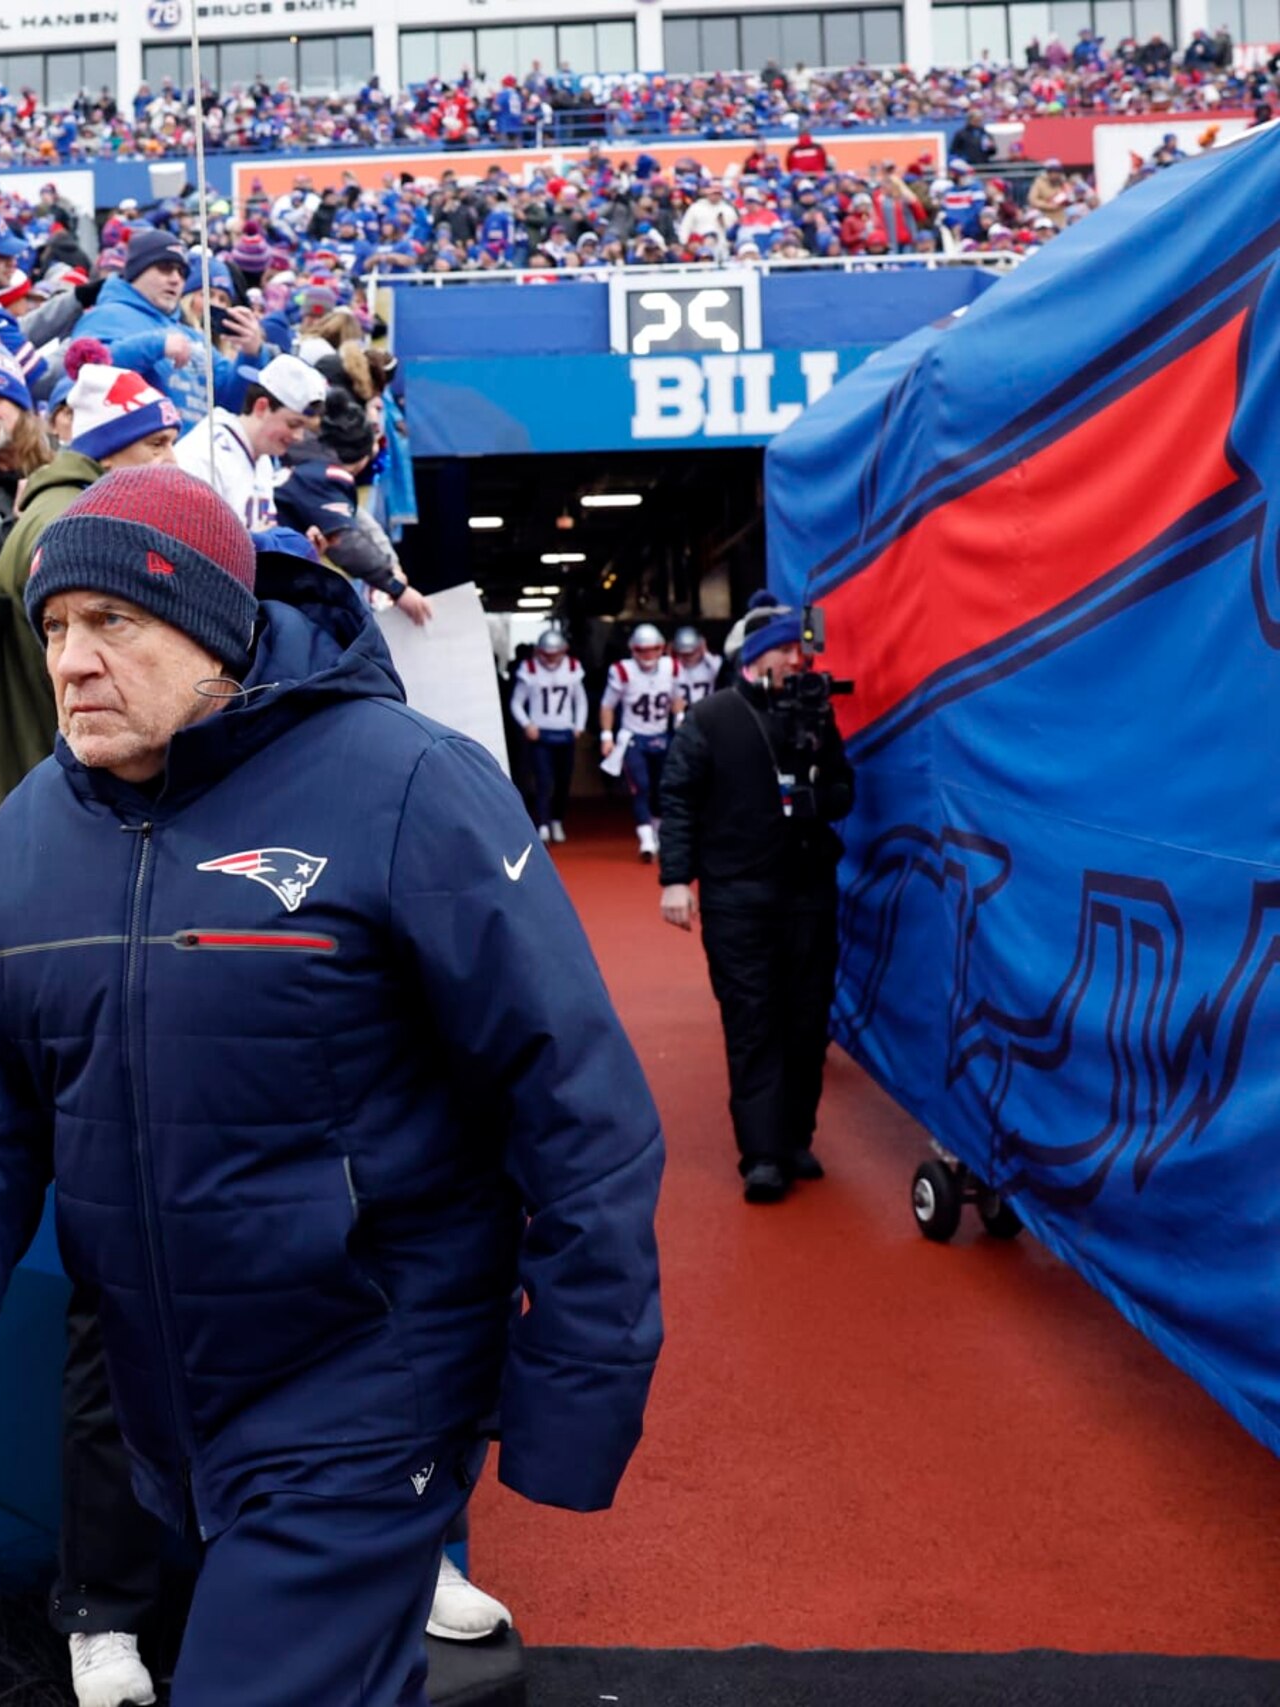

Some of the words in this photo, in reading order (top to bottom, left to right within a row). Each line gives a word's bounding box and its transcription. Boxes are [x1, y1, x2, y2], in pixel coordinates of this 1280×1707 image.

[22, 12, 117, 28] HANSEN
[197, 2, 272, 17] BRUCE
[284, 0, 357, 11] SMITH
[540, 686, 568, 715] 17
[631, 692, 671, 722] 49
